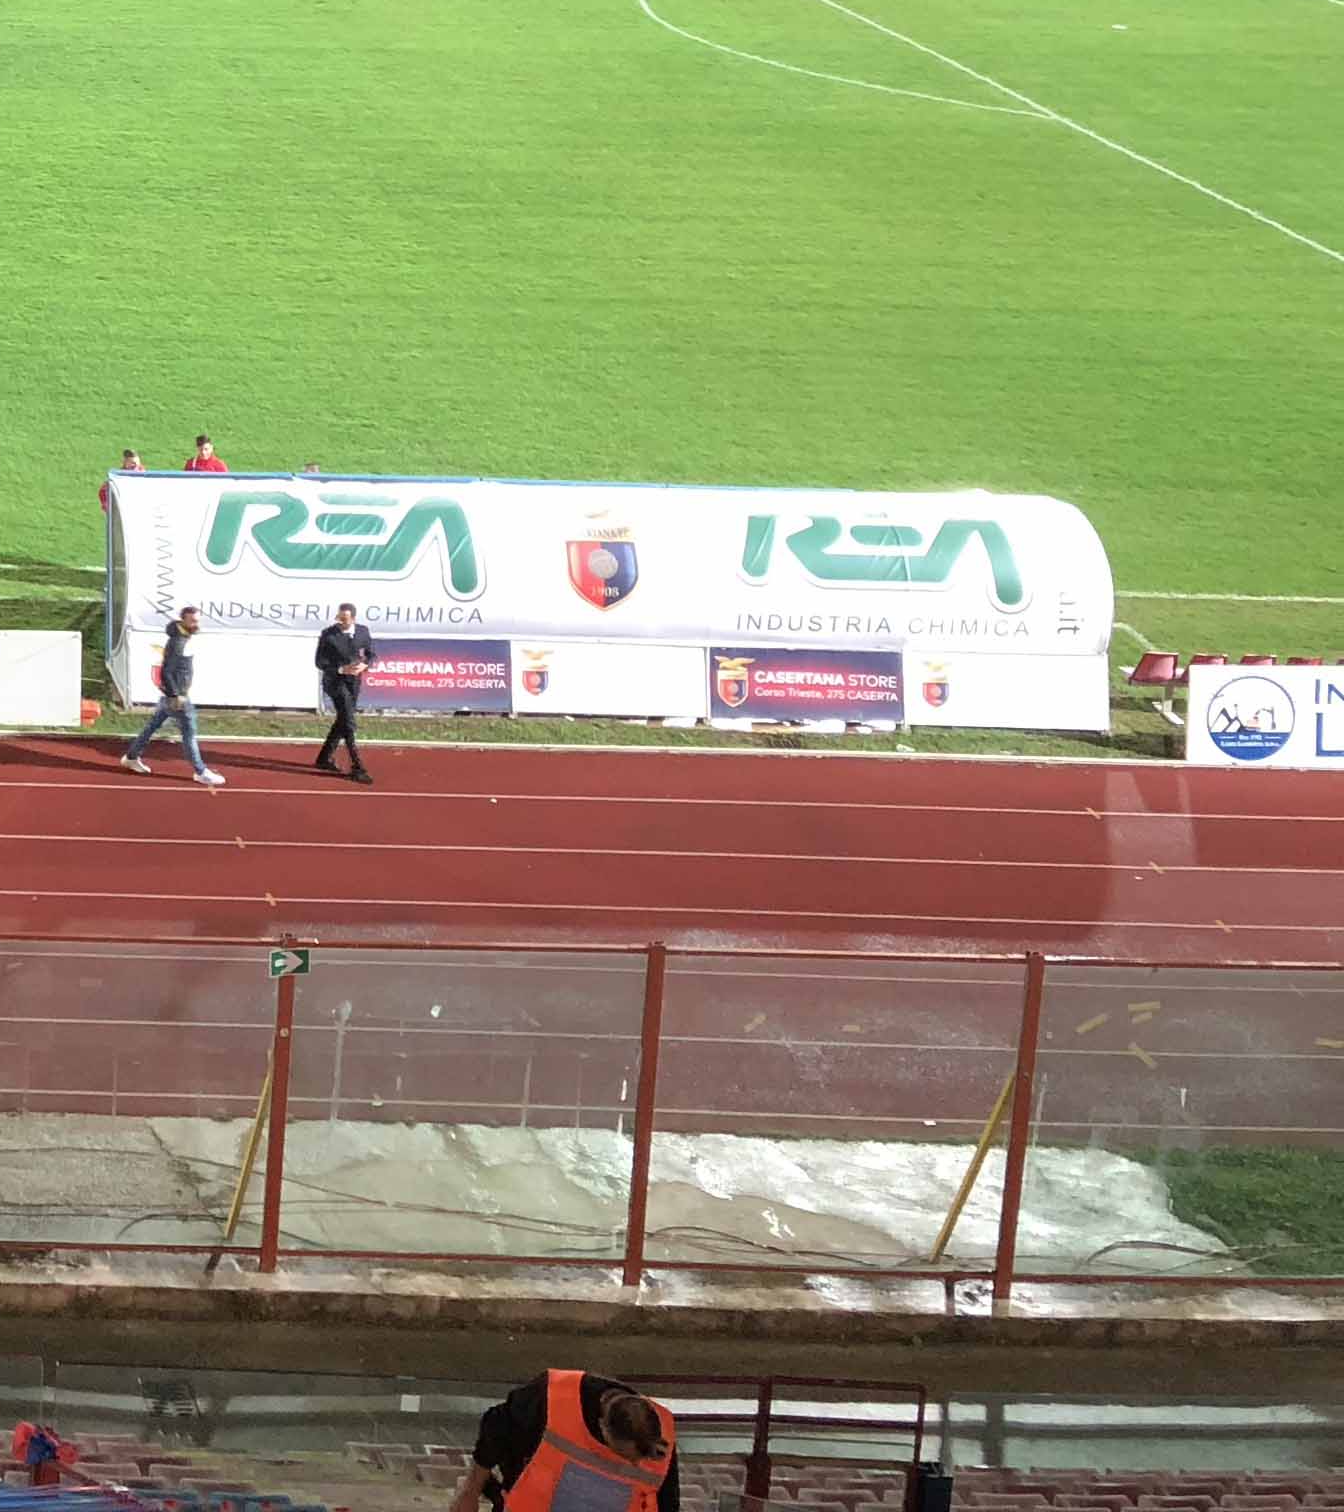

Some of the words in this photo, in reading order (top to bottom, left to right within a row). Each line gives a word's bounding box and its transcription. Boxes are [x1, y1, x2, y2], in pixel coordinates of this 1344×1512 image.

[199, 600, 342, 623] INDUSTRI
[365, 604, 483, 624] CHIMICA
[735, 613, 893, 635] INDUSTRIA
[907, 616, 1031, 637] CHIMICA
[457, 662, 506, 676] STORE
[456, 678, 507, 689] CASERTA
[753, 670, 845, 686] CASERTANA
[847, 674, 898, 689] STORE
[847, 690, 899, 703] CASERTA
